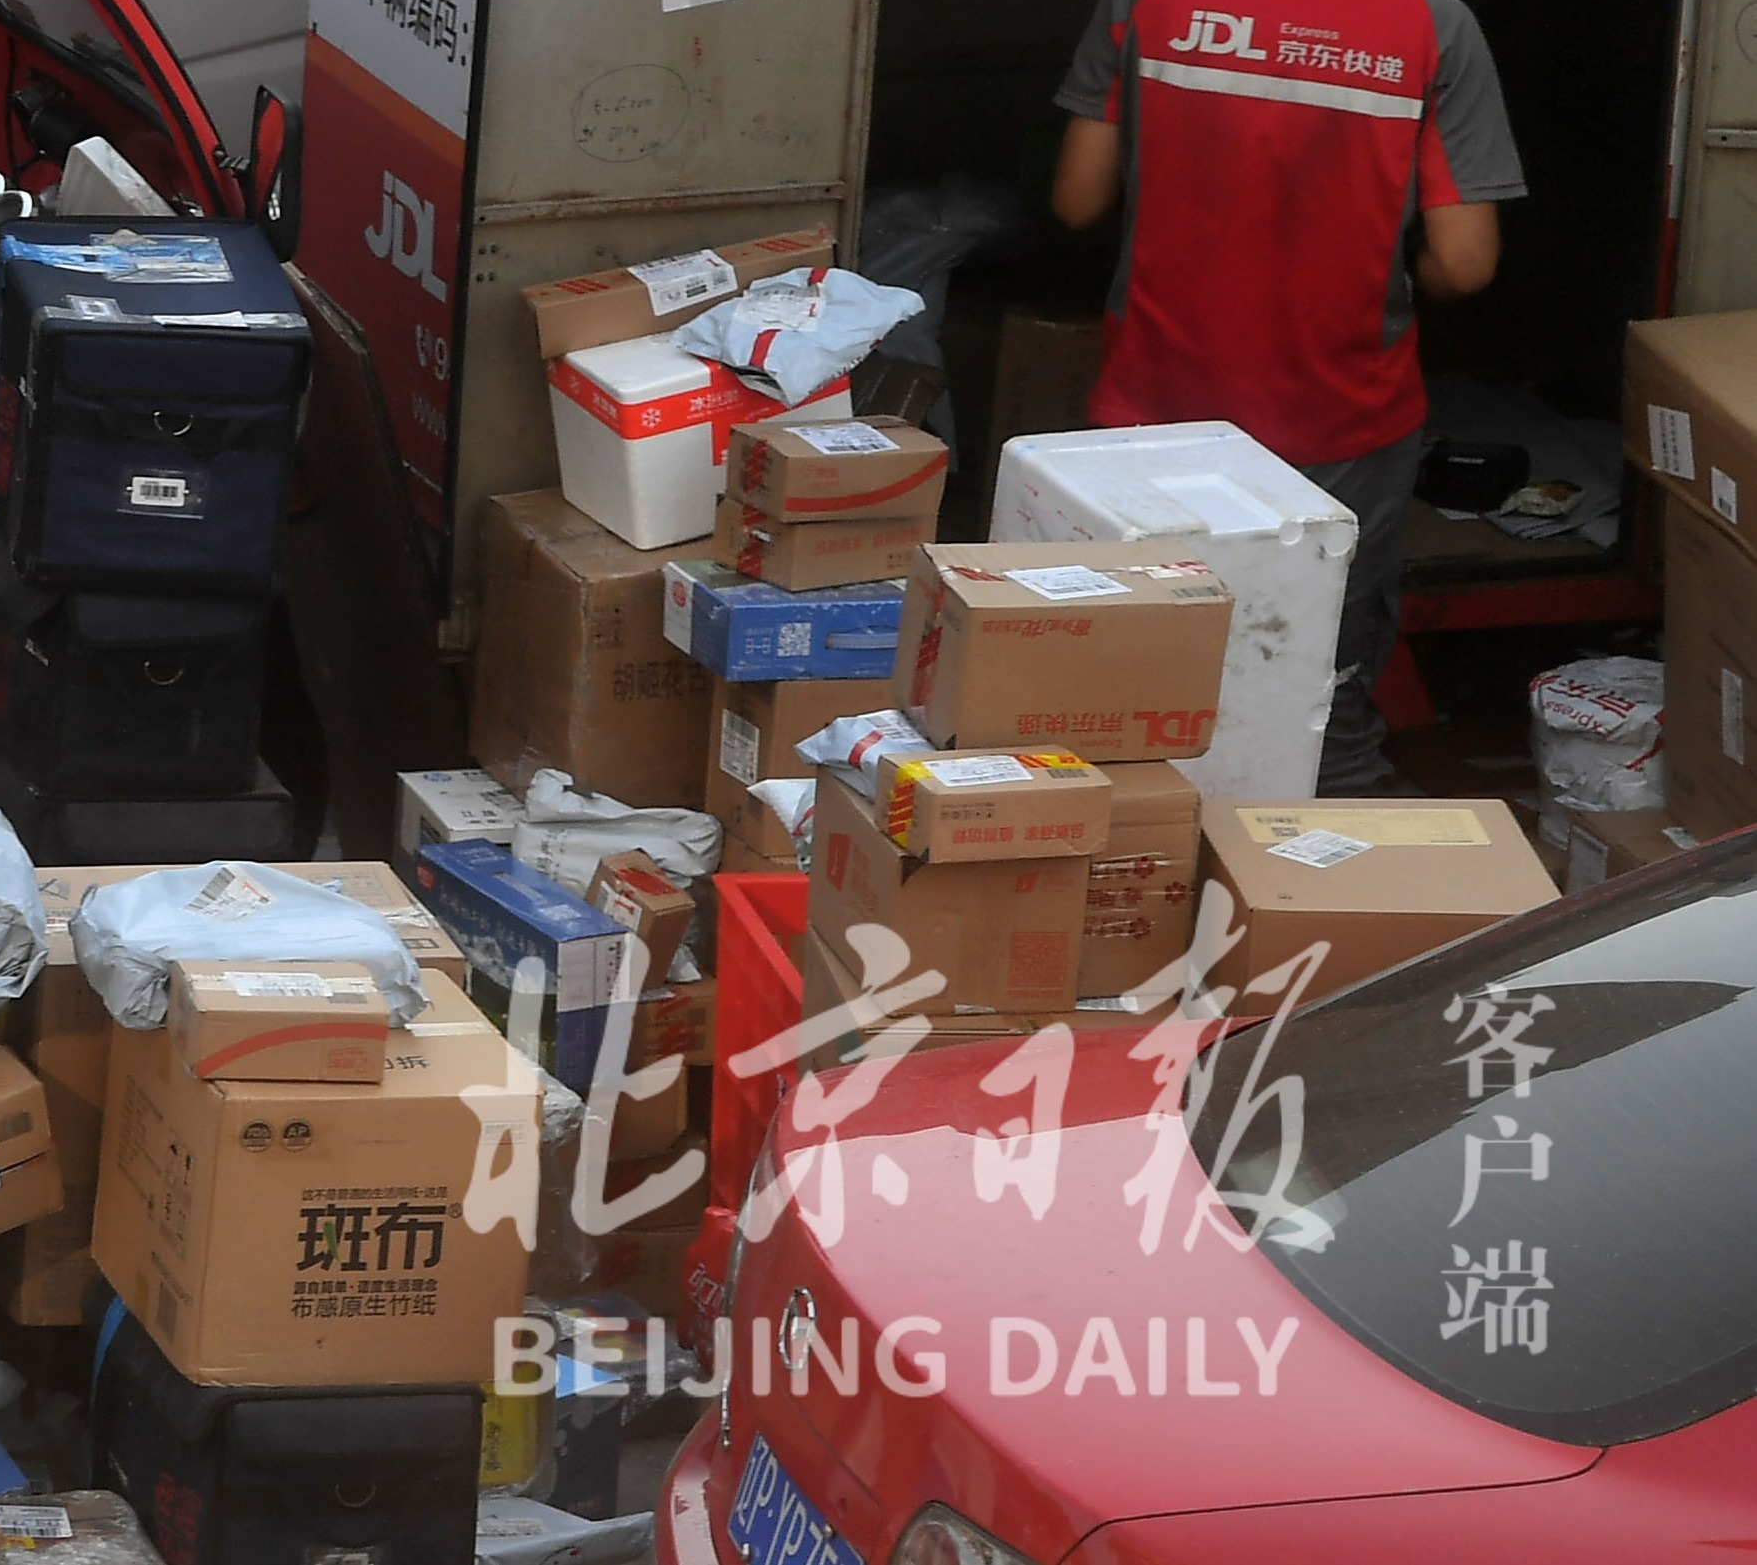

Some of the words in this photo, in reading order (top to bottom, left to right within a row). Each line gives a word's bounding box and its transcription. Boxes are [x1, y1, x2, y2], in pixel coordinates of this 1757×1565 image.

[1168, 9, 1267, 63] JDL
[1276, 39, 1405, 85] 京东快递
[364, 171, 447, 303] JDL
[1015, 710, 1124, 737] 京东快递
[1132, 707, 1218, 747] JDL
[296, 1202, 448, 1273] 斑布
[290, 1295, 438, 1319] 布感原生竹纸
